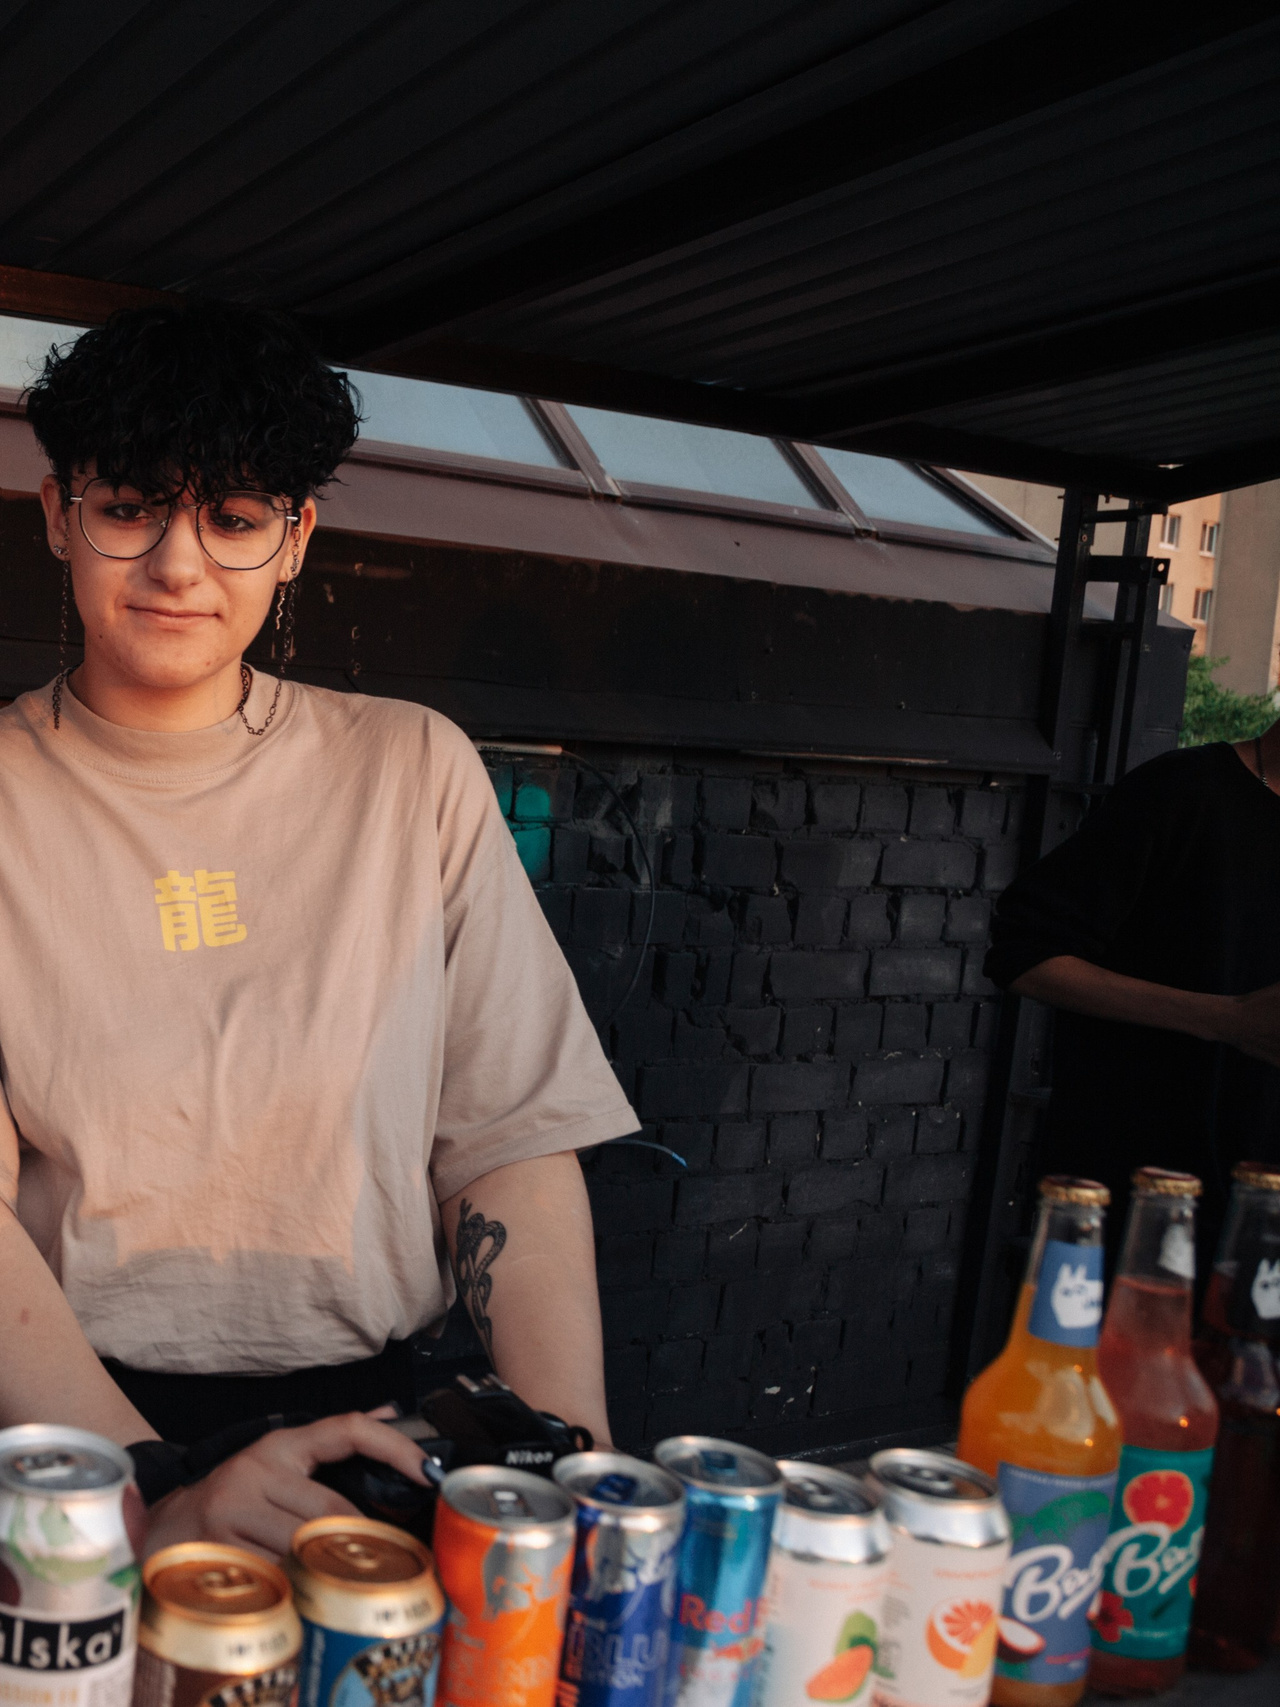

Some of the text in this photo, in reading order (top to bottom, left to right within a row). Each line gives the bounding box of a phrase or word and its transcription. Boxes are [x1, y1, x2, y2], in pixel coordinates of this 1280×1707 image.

[154, 869, 248, 951] 龍
[506, 1450, 553, 1464] Nikon
[679, 1593, 753, 1633] Red
